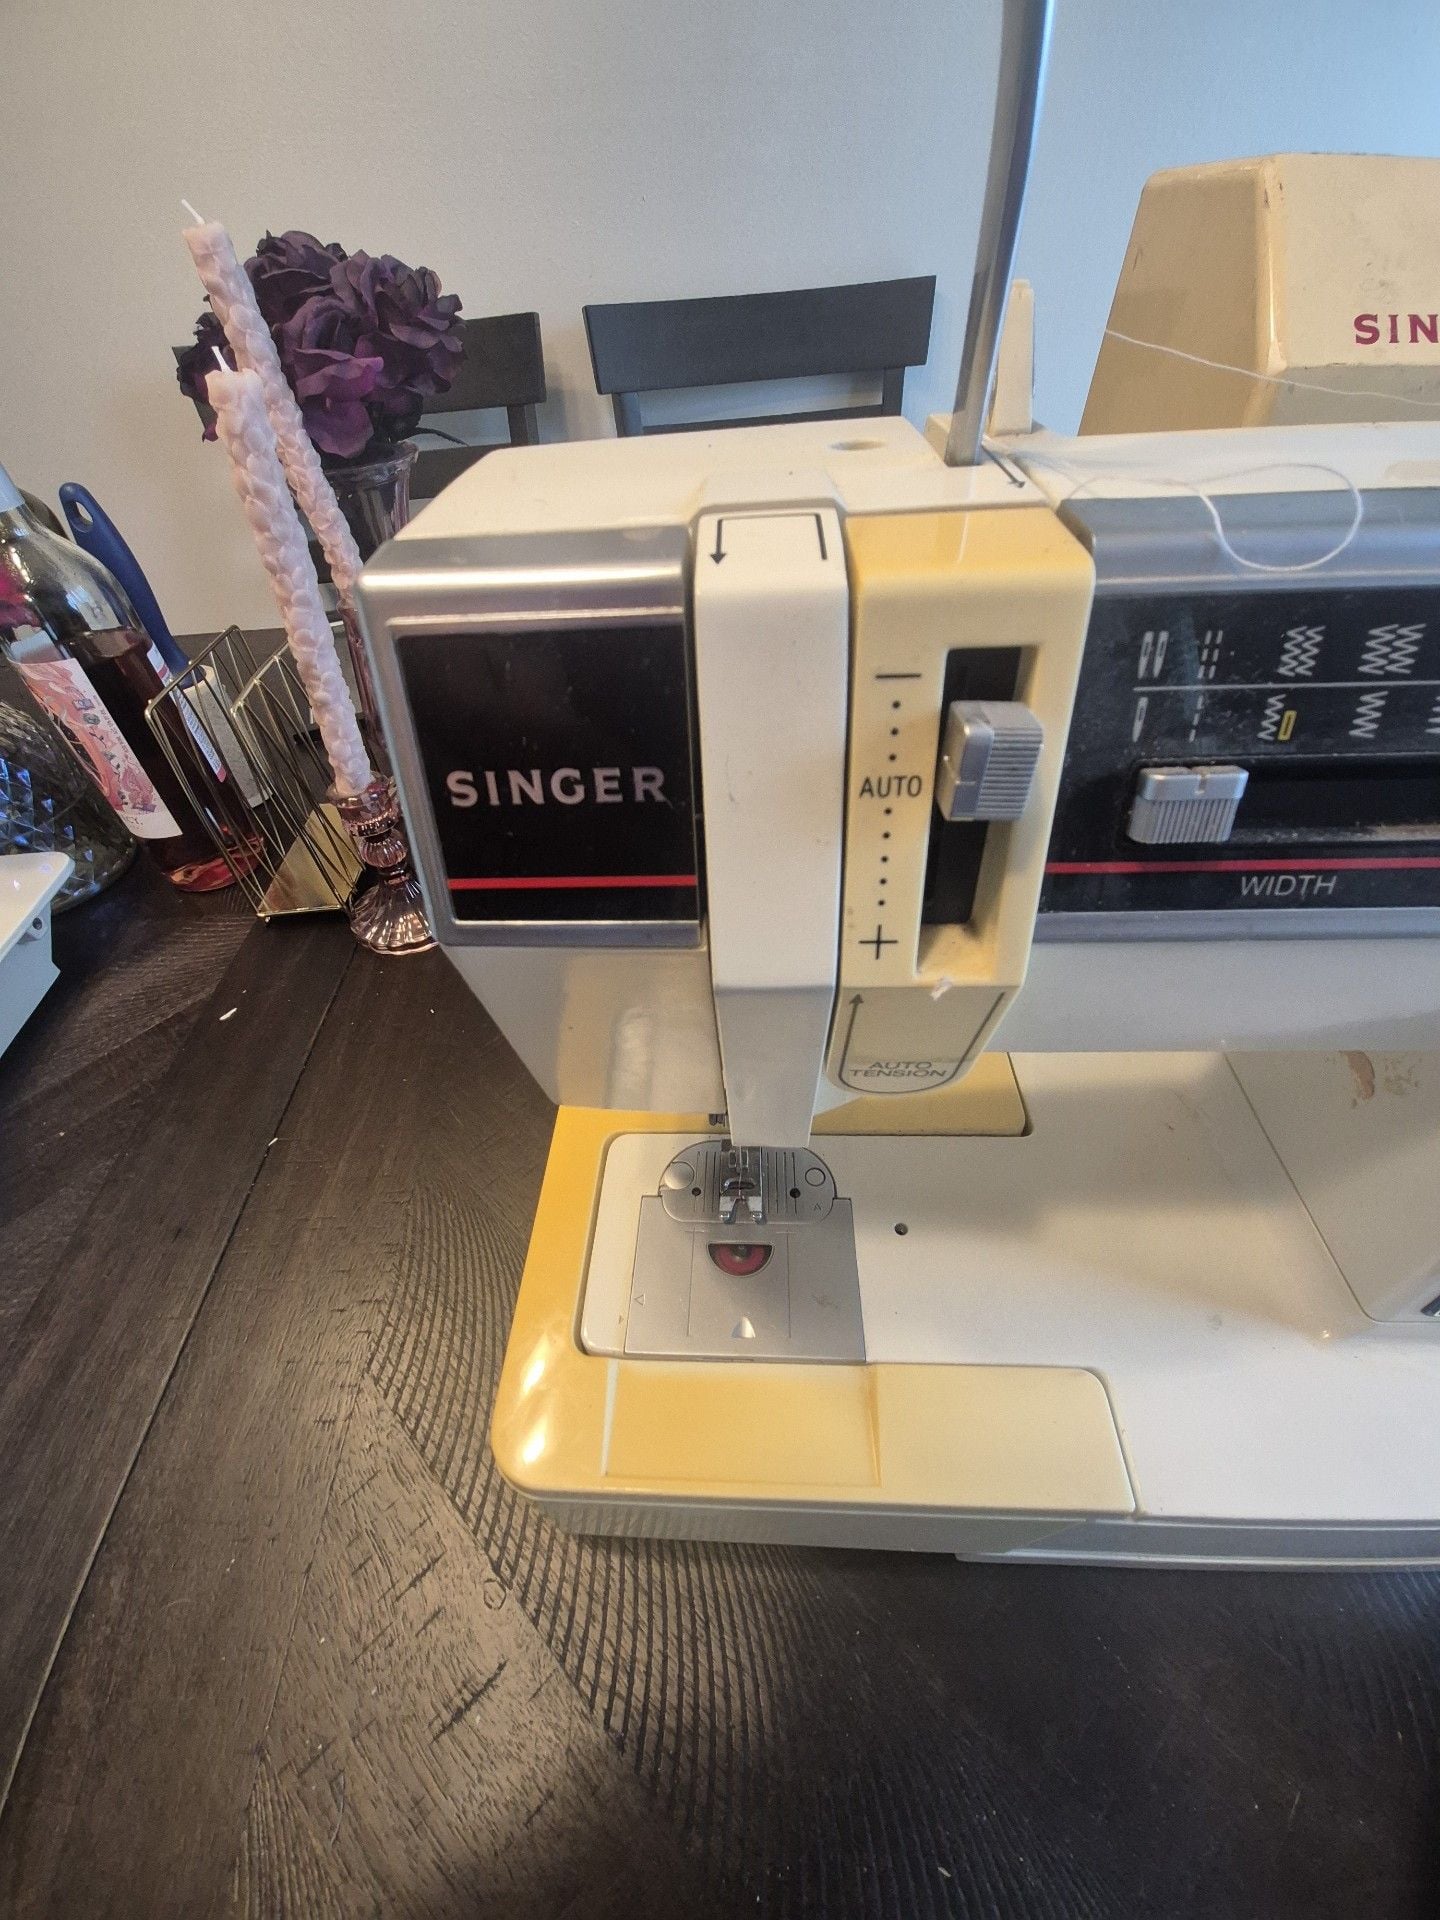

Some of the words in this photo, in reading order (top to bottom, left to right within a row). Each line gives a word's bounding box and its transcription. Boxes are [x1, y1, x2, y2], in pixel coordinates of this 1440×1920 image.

[1354, 313, 1439, 345] SIN
[446, 766, 670, 807] SINGER
[859, 774, 923, 798] AUTO
[1241, 875, 1338, 897] WIDTH
[850, 1069, 948, 1078] TENSION
[868, 1060, 932, 1070] AUTO
